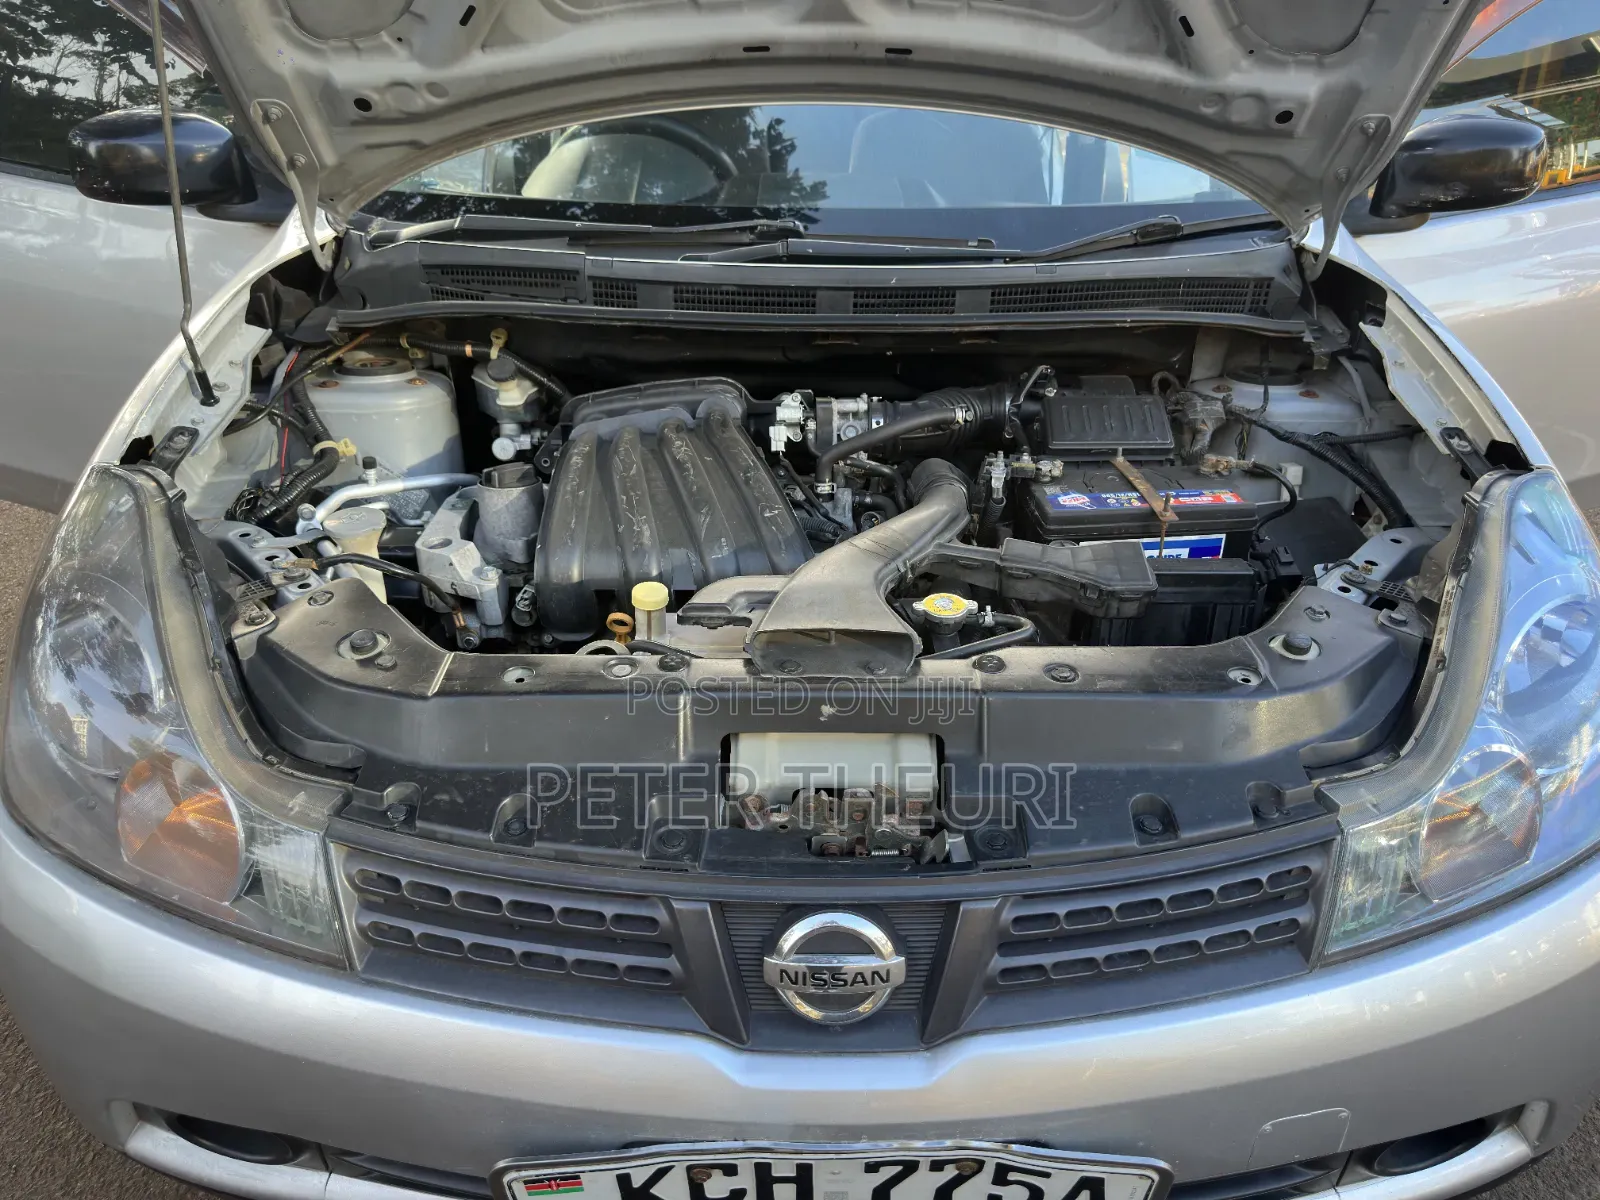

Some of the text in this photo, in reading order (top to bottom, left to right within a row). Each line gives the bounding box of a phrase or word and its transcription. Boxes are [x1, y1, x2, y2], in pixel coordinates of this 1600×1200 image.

[779, 969, 890, 988] NISSAN
[616, 1158, 1106, 1200] KCH 775A
